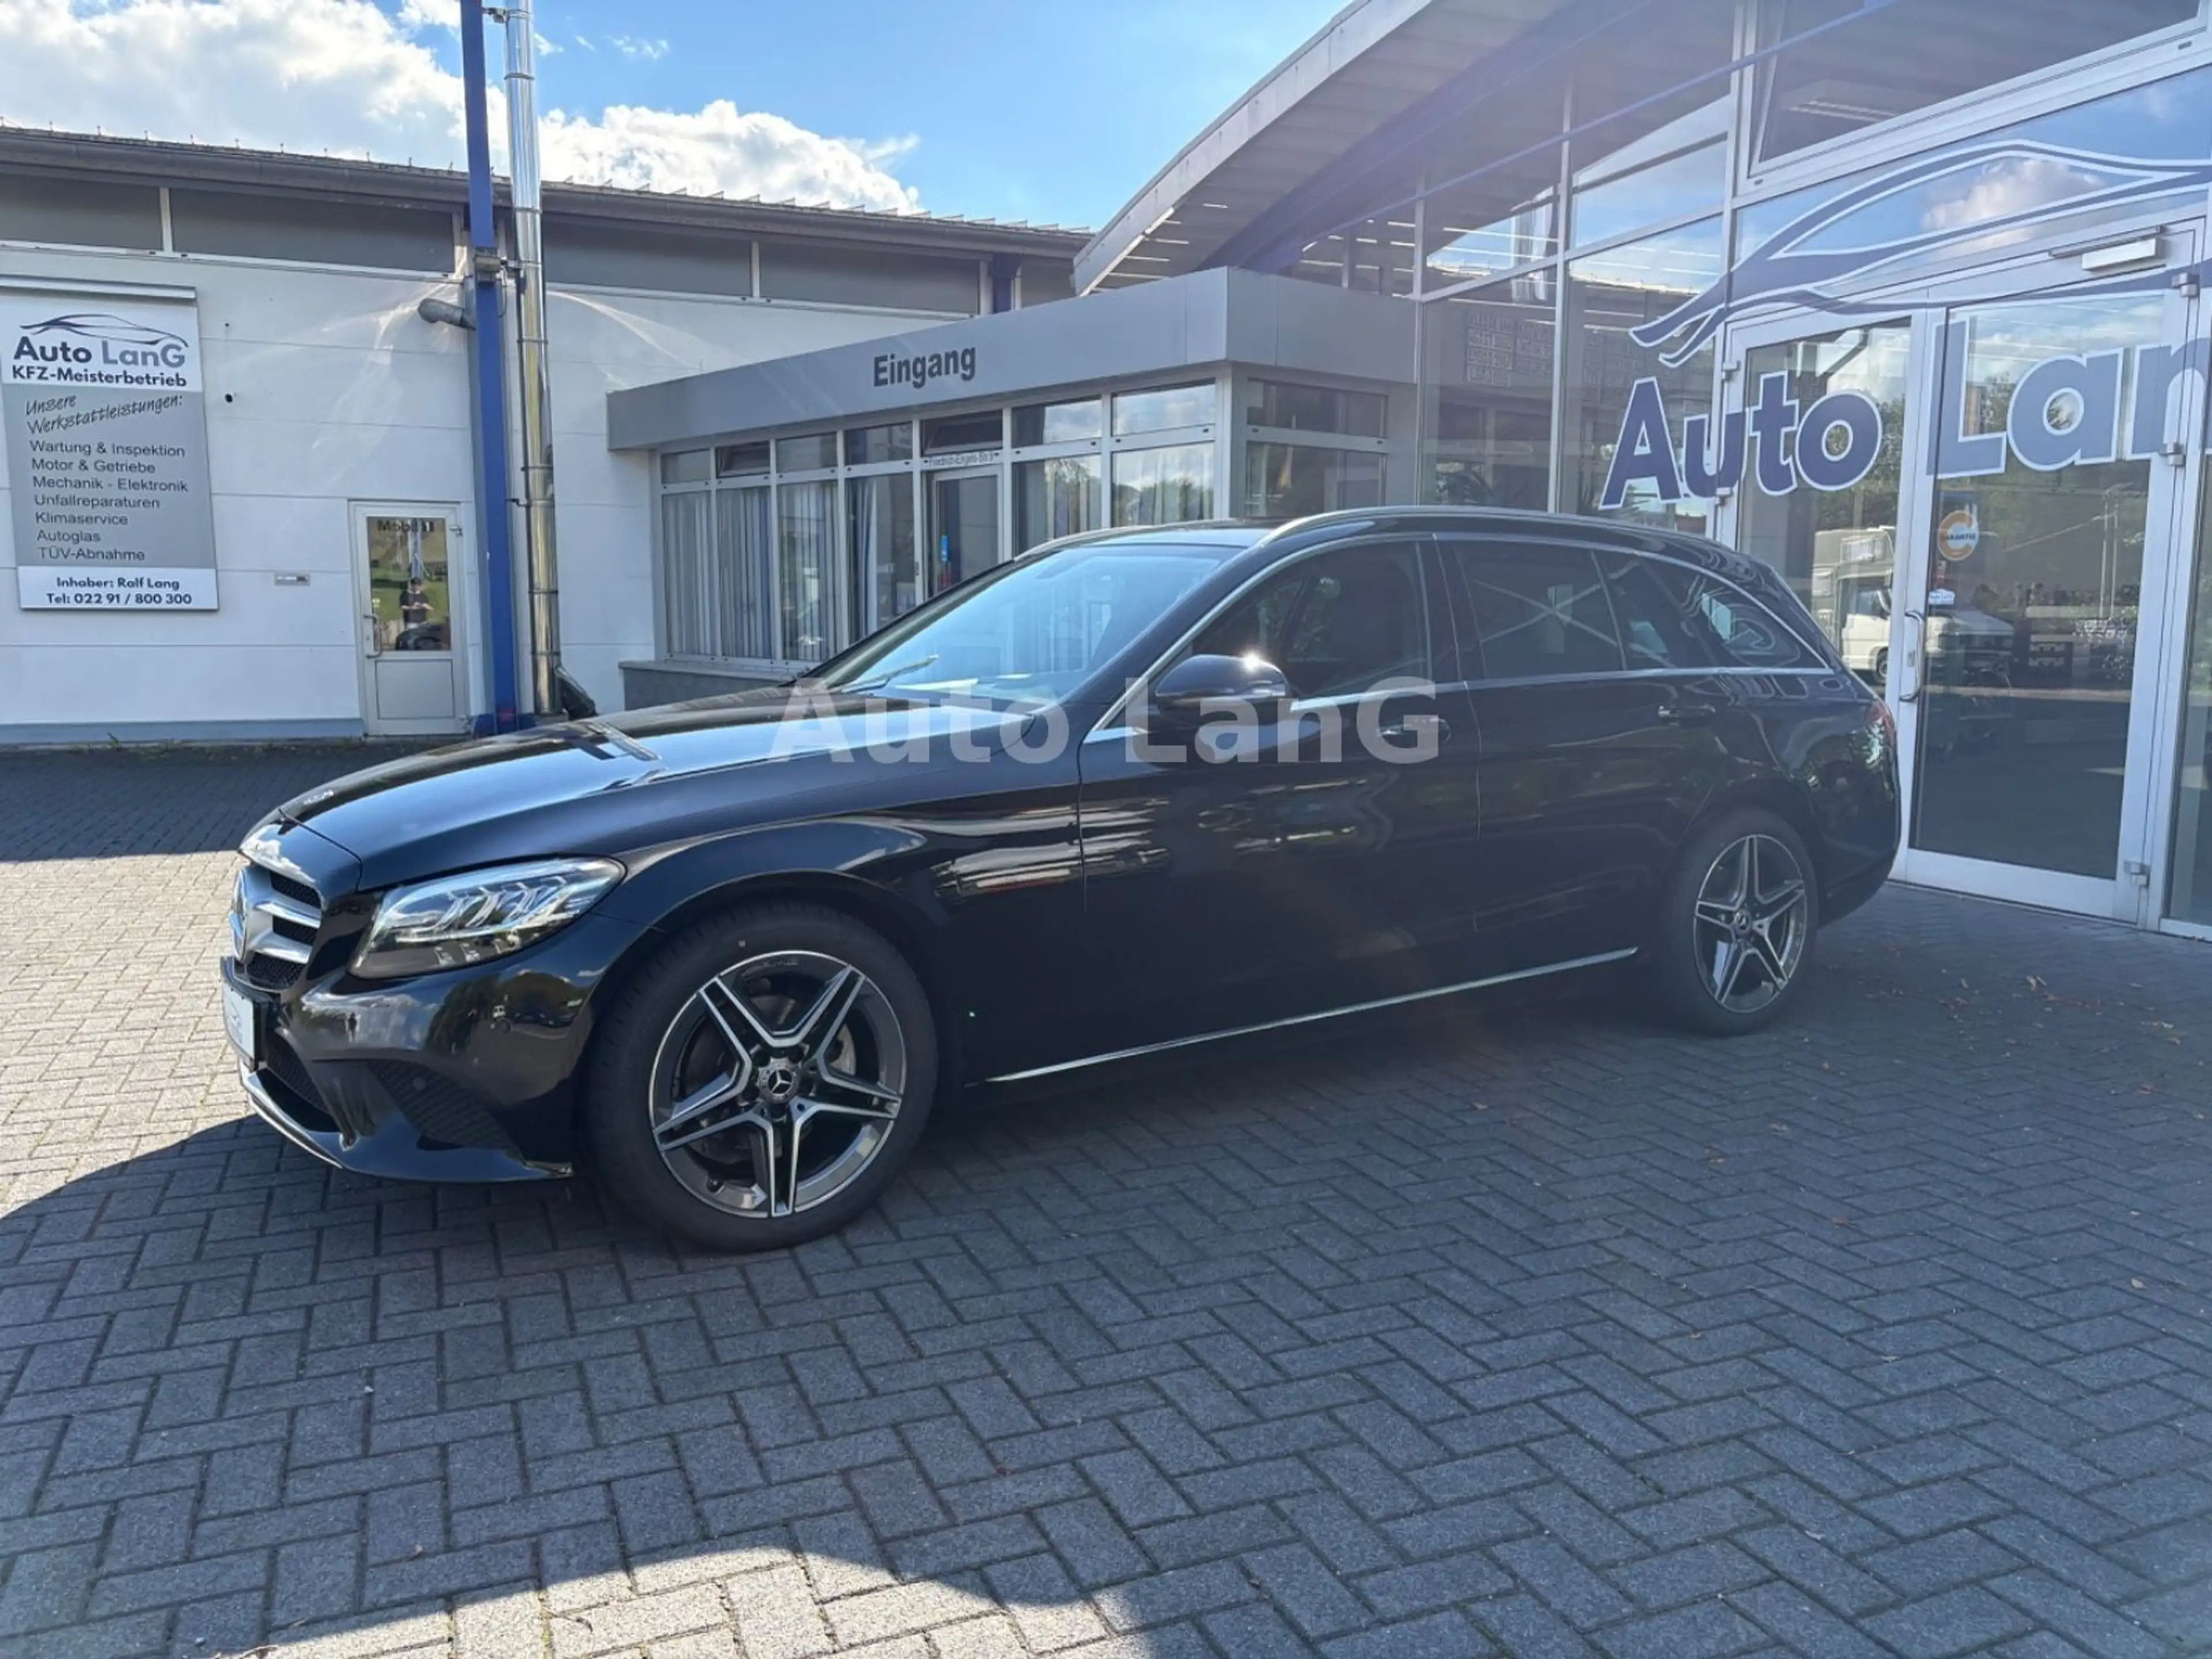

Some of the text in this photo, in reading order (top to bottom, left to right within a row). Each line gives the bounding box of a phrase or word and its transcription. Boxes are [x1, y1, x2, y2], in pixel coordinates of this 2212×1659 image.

[13, 336, 185, 368] Auto LanG
[12, 365, 187, 387] KFZ-Meisterbetrieb
[873, 346, 976, 390] Eingang
[26, 395, 77, 416] Unsere
[26, 395, 183, 435] Werkstattleistungen:
[29, 440, 185, 457] Wartung & Inspektion
[1599, 370, 1883, 510] Auto
[31, 458, 156, 474] Motor & Getriebe
[33, 476, 103, 489] Mechanik
[118, 478, 188, 493] Elektronik
[34, 494, 160, 509] Unfallreparaturen
[35, 511, 128, 525] Klimaservice
[37, 529, 101, 544] Autoglas
[38, 545, 145, 561] TÜV-Abnahme
[56, 577, 180, 591] Inhaber: Ralf Lang
[46, 593, 192, 605] Tel: 022 91 / 800 300
